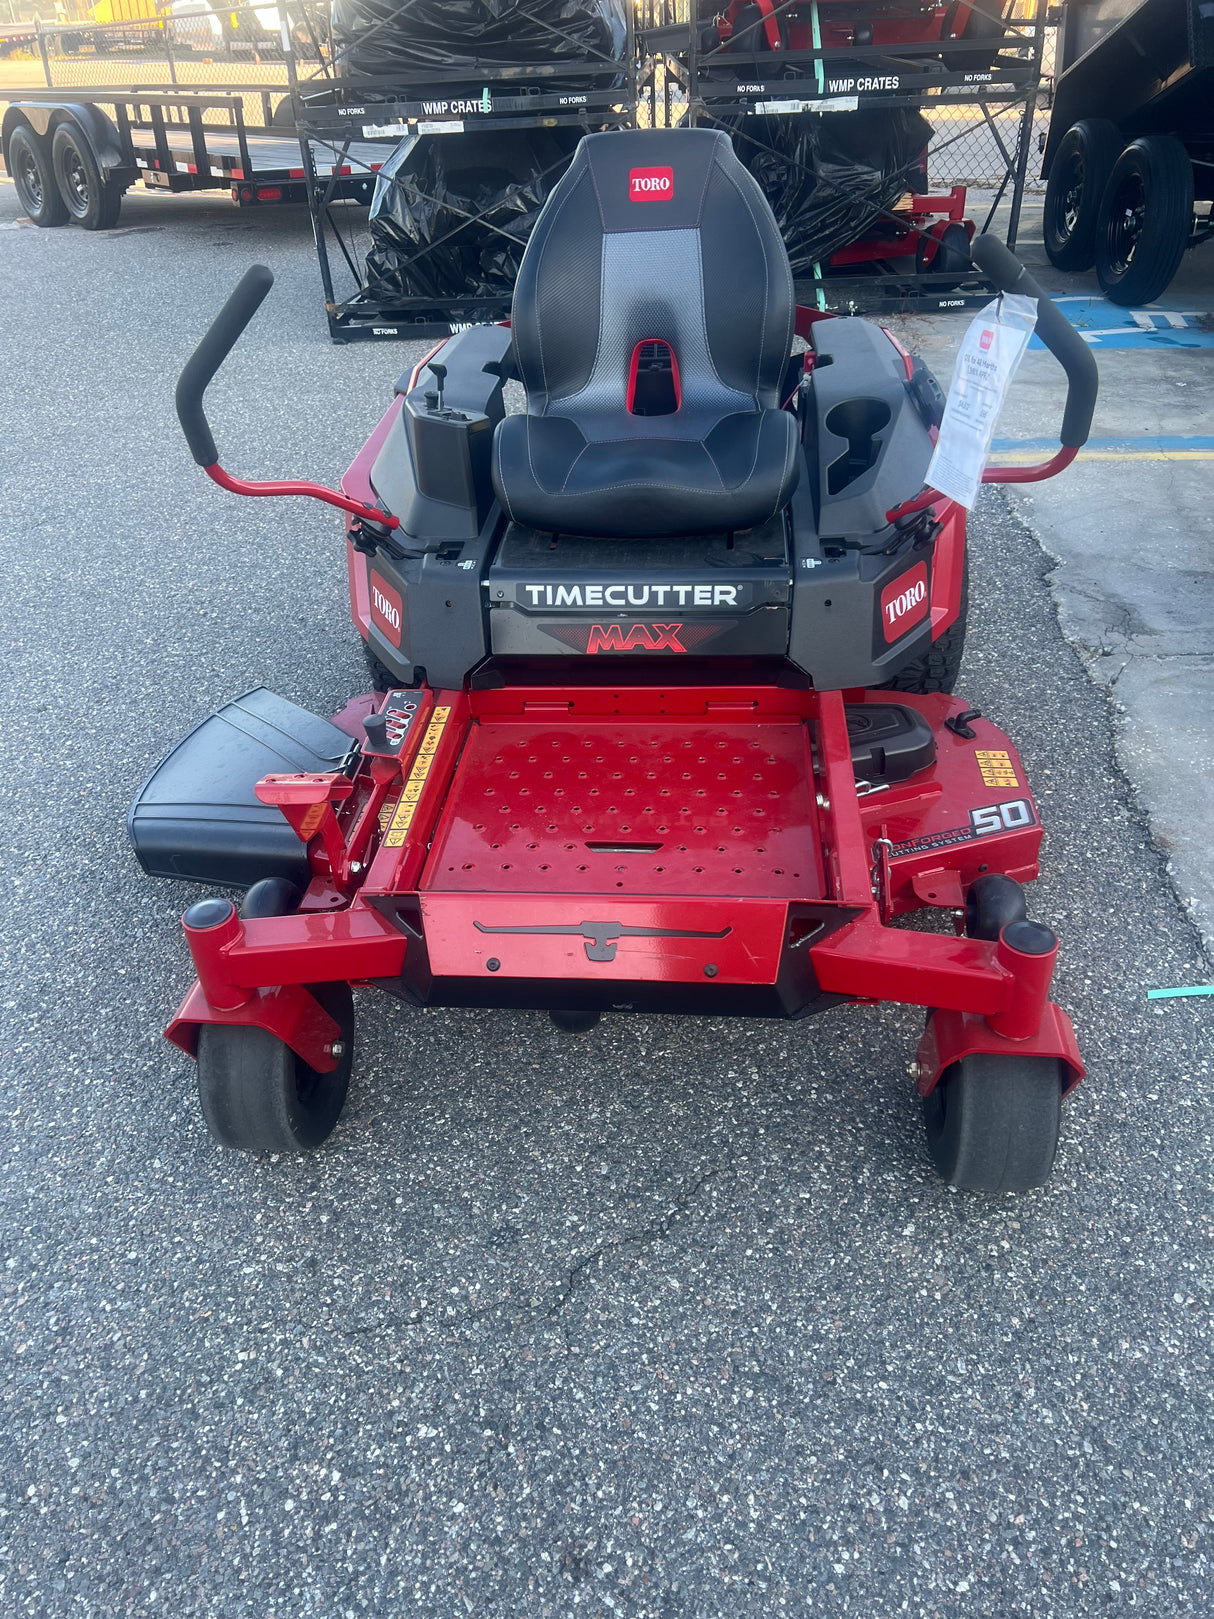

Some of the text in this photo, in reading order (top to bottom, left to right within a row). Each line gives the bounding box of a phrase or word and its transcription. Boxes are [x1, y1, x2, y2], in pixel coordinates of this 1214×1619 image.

[829, 75, 900, 93] WMP CRATES
[964, 73, 992, 82] NO FORKS
[736, 85, 746, 93] NO
[422, 98, 493, 115] WMP CRATES
[559, 95, 587, 105] NO FORKS
[337, 107, 365, 116] NO FORKS
[631, 177, 670, 192] TORO
[372, 586, 400, 629] TORO
[885, 580, 925, 625] TORO
[585, 622, 689, 655] MAX
[971, 800, 1031, 835] 50
[892, 827, 972, 852] ONFORGED
[931, 834, 973, 848] SYSTEM
